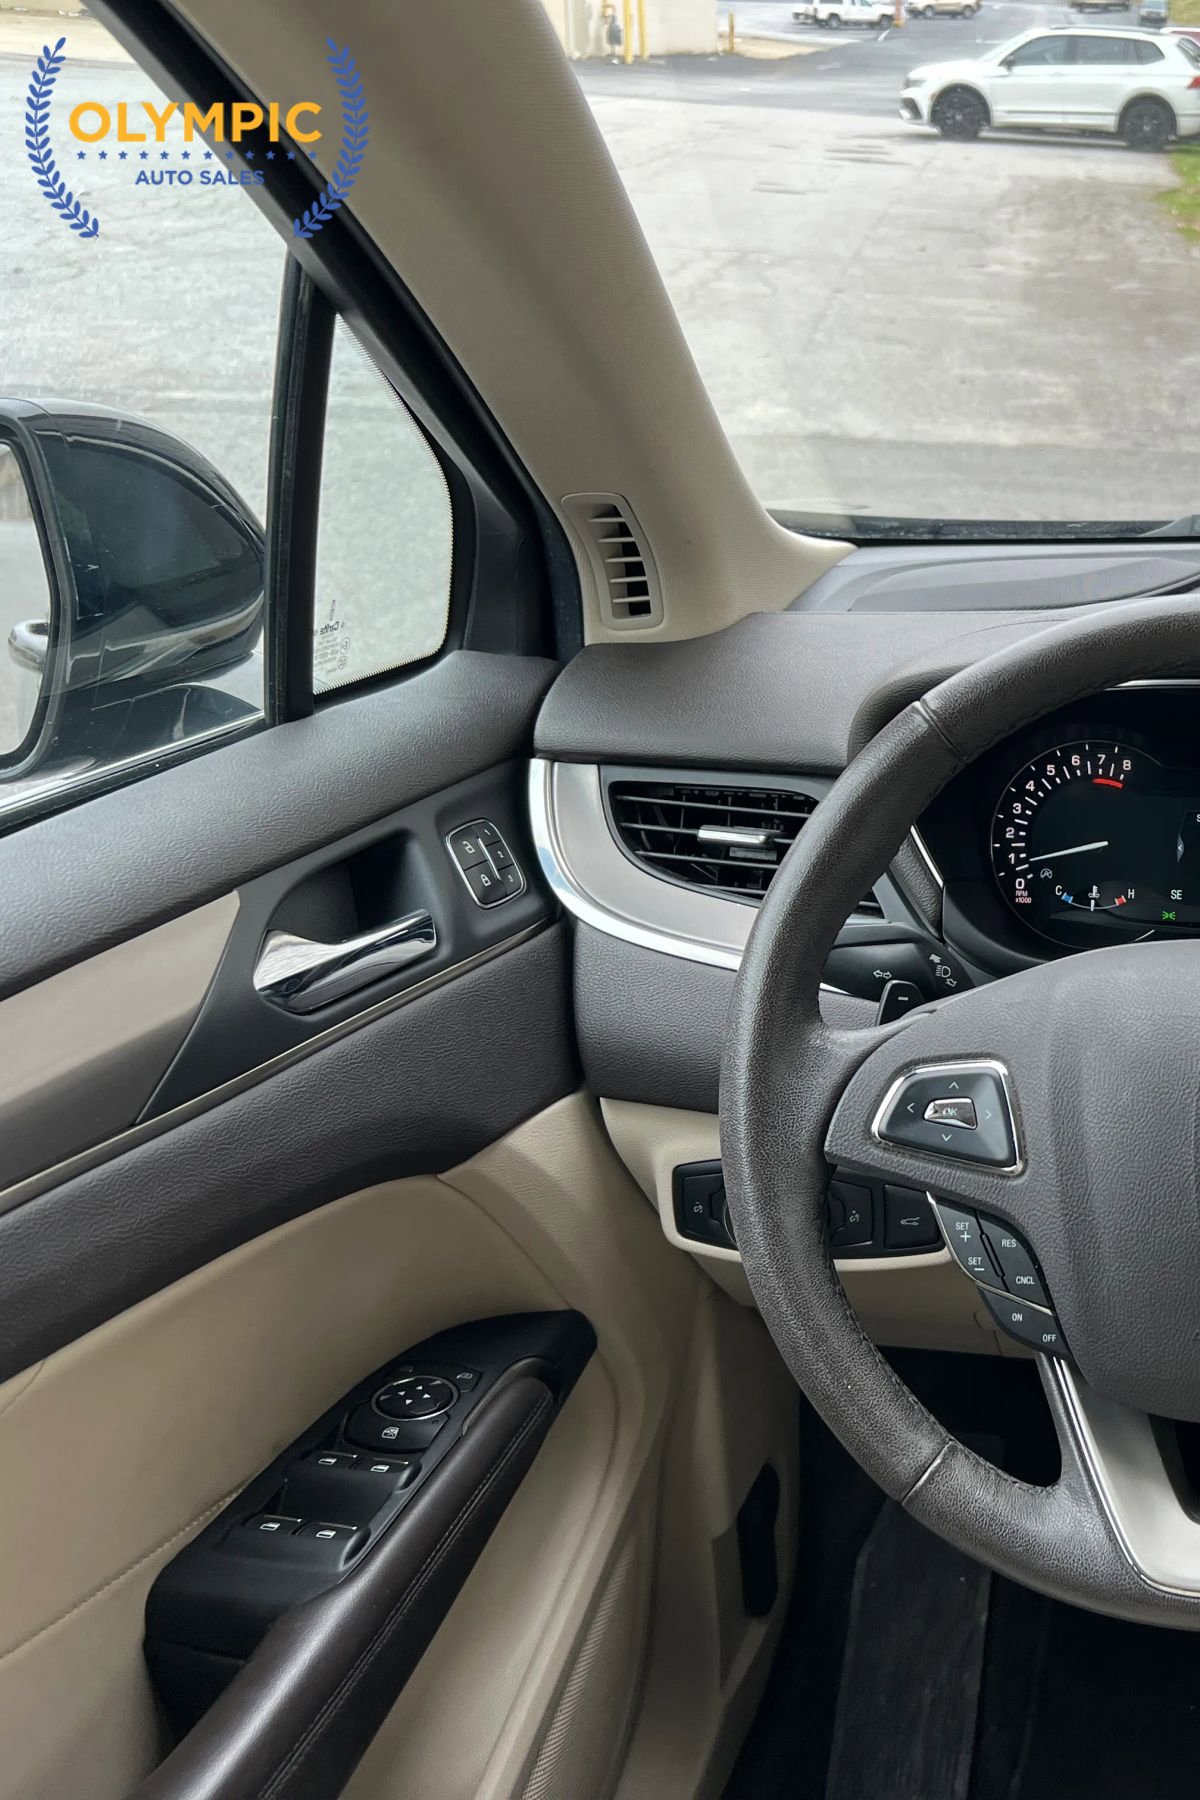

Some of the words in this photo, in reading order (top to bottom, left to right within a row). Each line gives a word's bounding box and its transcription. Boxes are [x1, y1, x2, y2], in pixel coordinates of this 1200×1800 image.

[1072, 755, 1080, 766] 6
[1097, 754, 1106, 764] 7
[1046, 764, 1055, 776] 5
[1122, 760, 1132, 770] 8
[1026, 780, 1035, 792] 4
[1012, 803, 1022, 814] 3
[1006, 827, 1014, 838] 2
[1008, 854, 1014, 864] 1
[1016, 878, 1024, 890] 0
[1056, 886, 1062, 896] C
[1128, 888, 1135, 898] H
[1170, 890, 1182, 900] SE
[956, 1222, 970, 1230] SET
[1002, 1238, 1017, 1248] RES
[968, 1257, 982, 1265] SET
[1016, 1276, 1036, 1284] CNCL
[1012, 1312, 1022, 1322] ON
[1042, 1334, 1056, 1342] OFF
